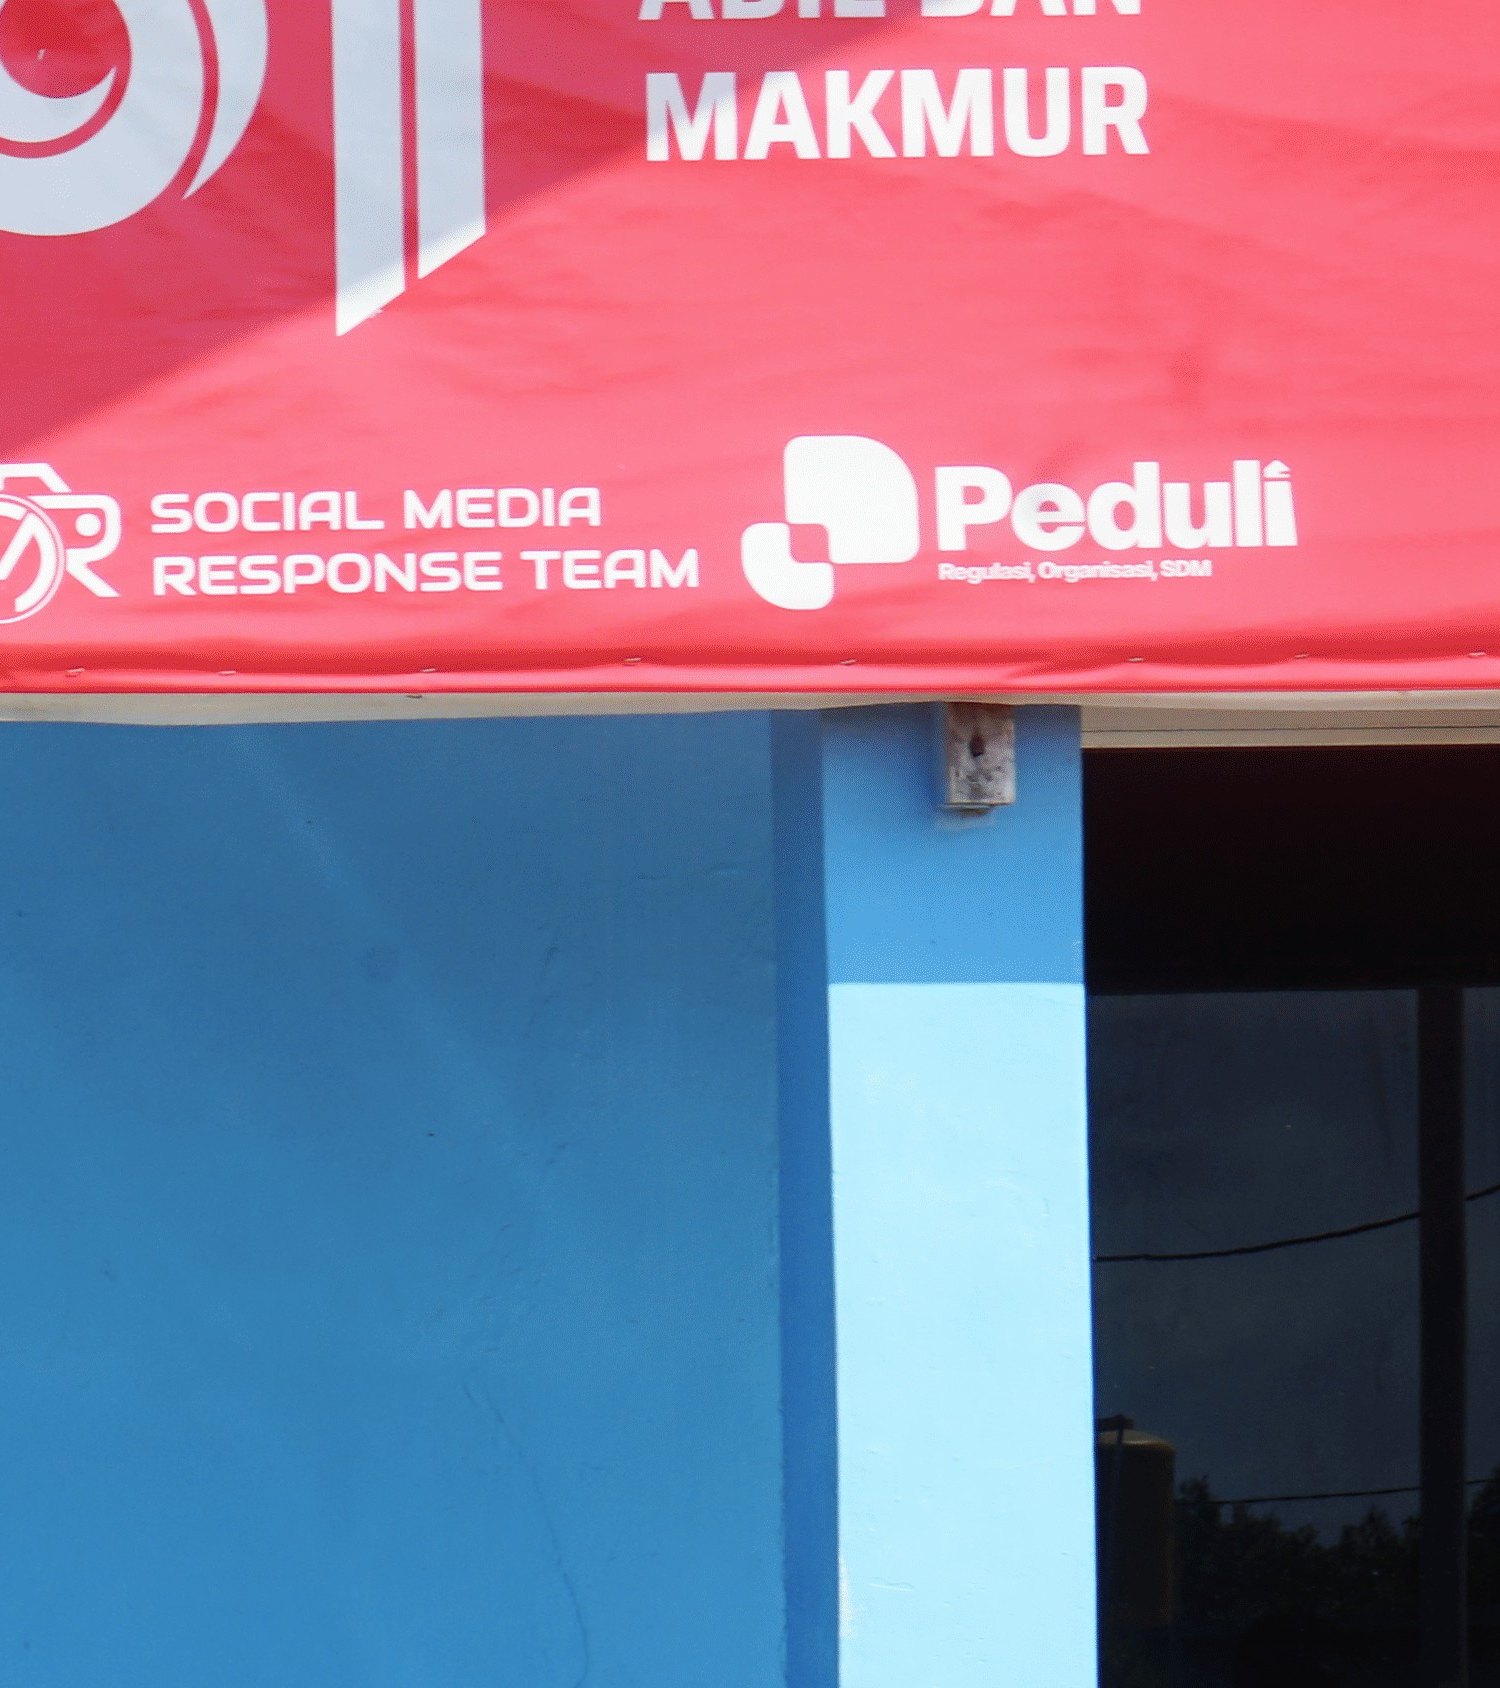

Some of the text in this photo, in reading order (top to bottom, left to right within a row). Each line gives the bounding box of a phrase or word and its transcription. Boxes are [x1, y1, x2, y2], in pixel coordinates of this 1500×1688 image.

[646, 66, 1150, 162] MAKMUR
[150, 487, 602, 534] SOCIAL MEDIA
[934, 459, 1299, 552] Peduli
[152, 548, 700, 596] RESPONSE TEAM
[938, 559, 1213, 585] Regulasi, Organisasi, SDM
